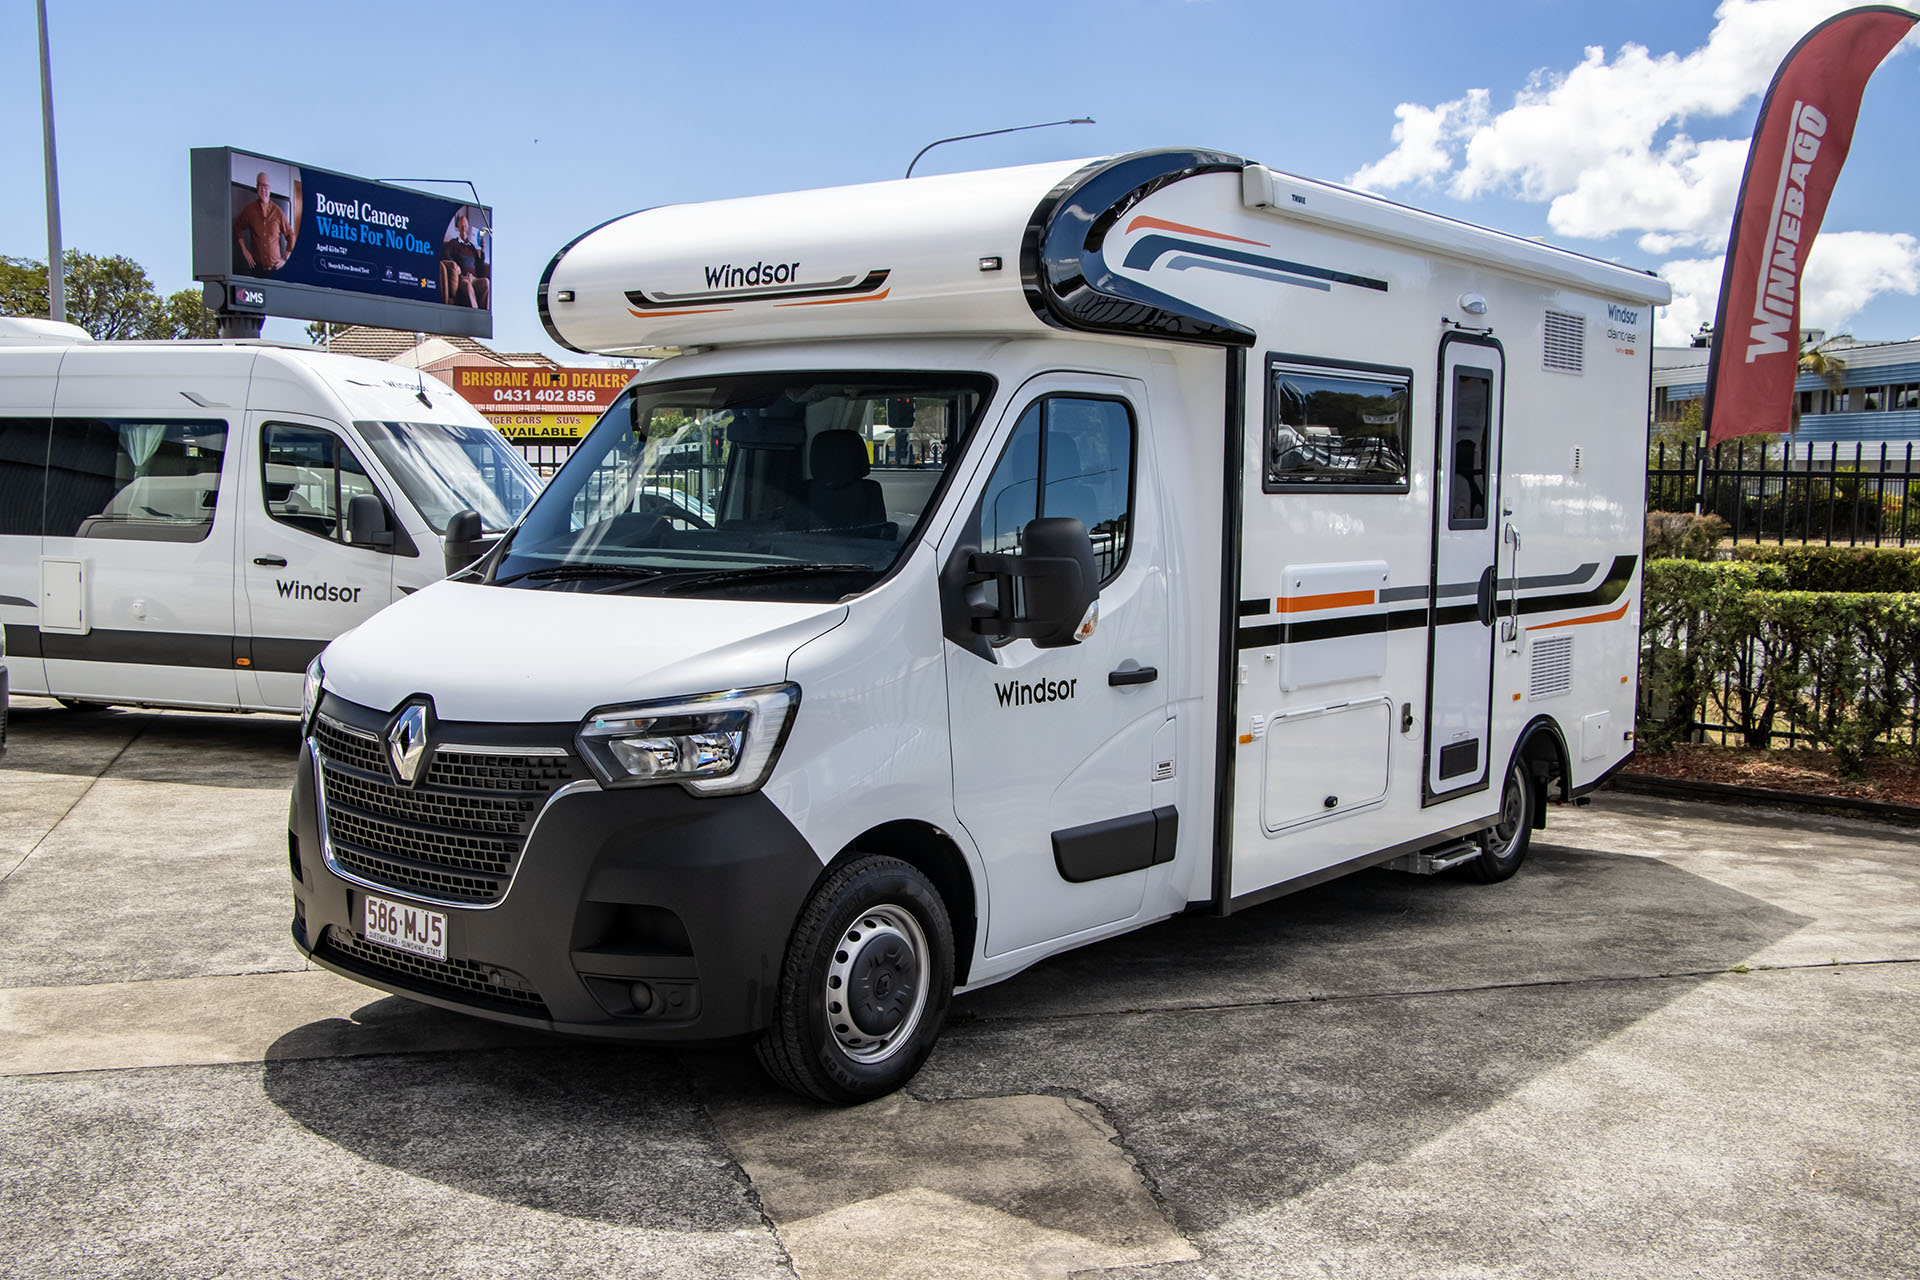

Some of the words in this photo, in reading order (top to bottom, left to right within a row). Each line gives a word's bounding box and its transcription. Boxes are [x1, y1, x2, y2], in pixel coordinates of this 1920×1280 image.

[316, 192, 359, 220] Bowel
[361, 202, 409, 230] Cancer
[316, 215, 358, 242] Waits
[360, 223, 384, 246] For
[386, 229, 403, 250] No
[405, 233, 434, 255] One.
[1745, 100, 1828, 363] WINNEBAGO
[704, 261, 800, 289] Windsor
[1607, 304, 1638, 325] Windsor
[462, 371, 528, 387] BRISBANE
[572, 373, 629, 388] DEALERS
[494, 389, 531, 401] 0431
[535, 389, 564, 402] 402
[567, 390, 597, 402] 856
[486, 416, 512, 424] NGER
[515, 416, 542, 424] CARS
[556, 416, 581, 424] SUVs
[499, 427, 578, 436] AVAILABLE
[276, 579, 361, 602] Windsor
[994, 677, 1077, 708] Windsor
[427, 946, 441, 957] STATE
